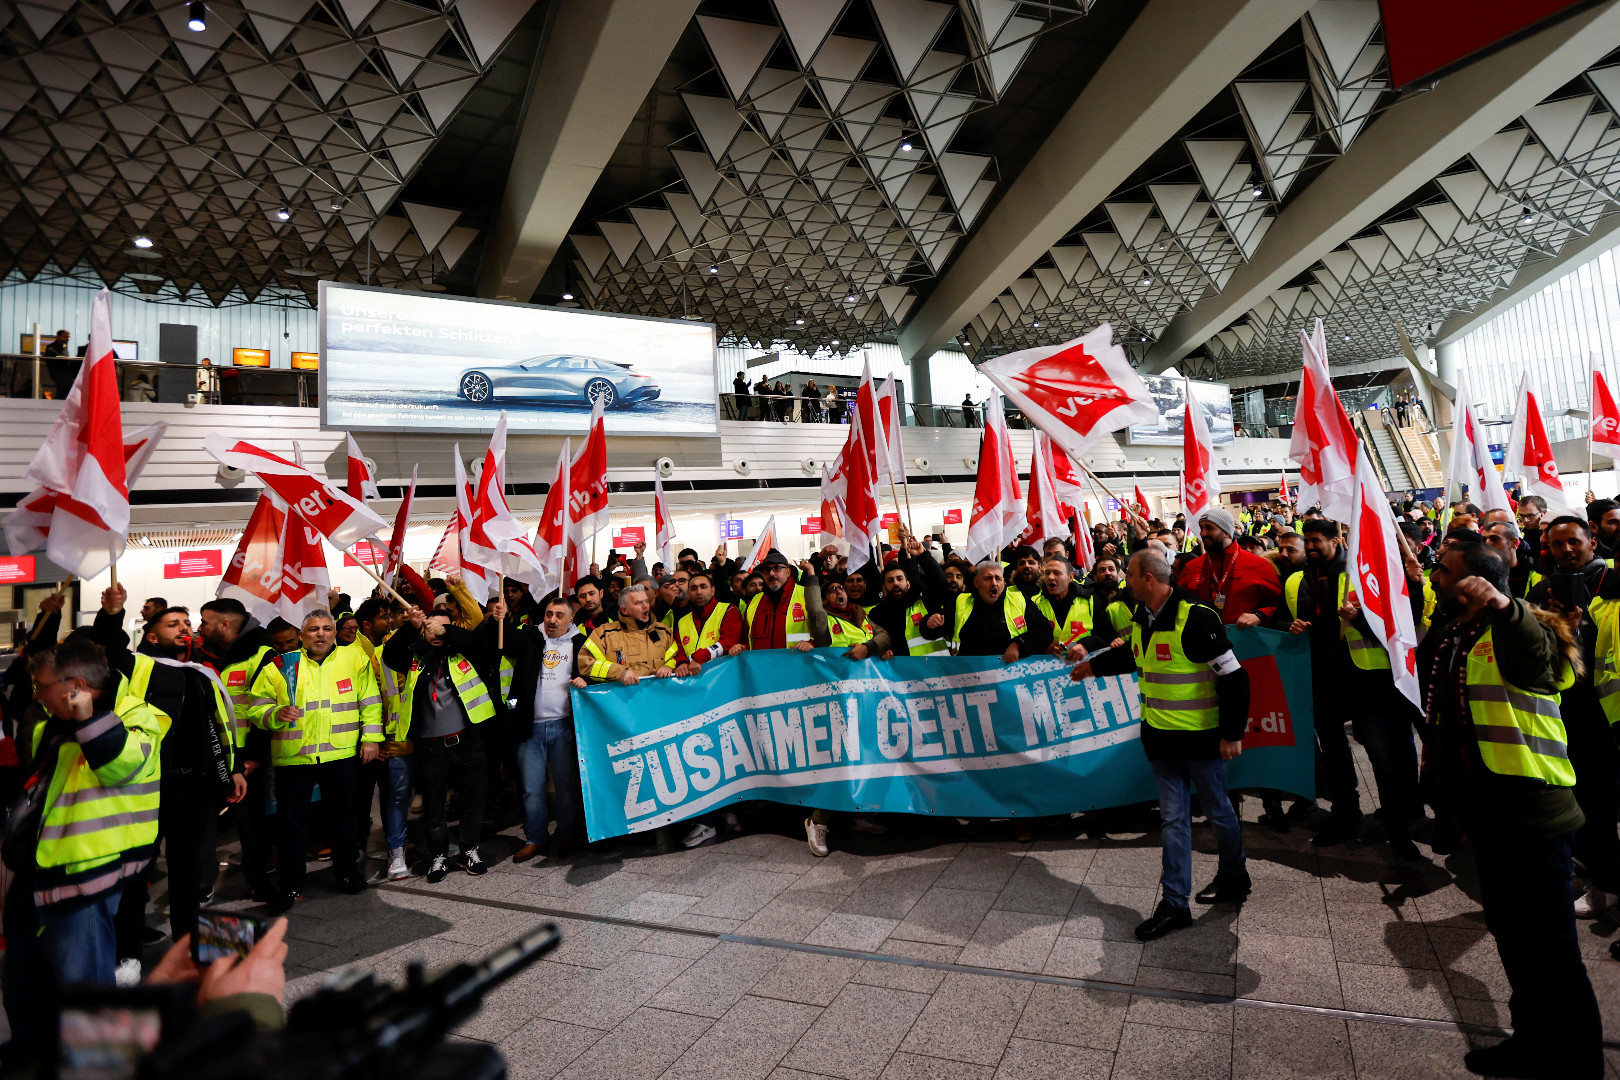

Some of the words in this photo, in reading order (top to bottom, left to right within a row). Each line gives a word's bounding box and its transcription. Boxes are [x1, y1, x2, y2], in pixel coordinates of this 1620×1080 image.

[340, 303, 406, 321] Unsere
[341, 321, 433, 338] perfekten
[551, 653, 569, 662] Rock
[1244, 711, 1287, 734] r.di
[614, 697, 860, 820] ZUSAMMEN
[876, 694, 1000, 761] GEHT
